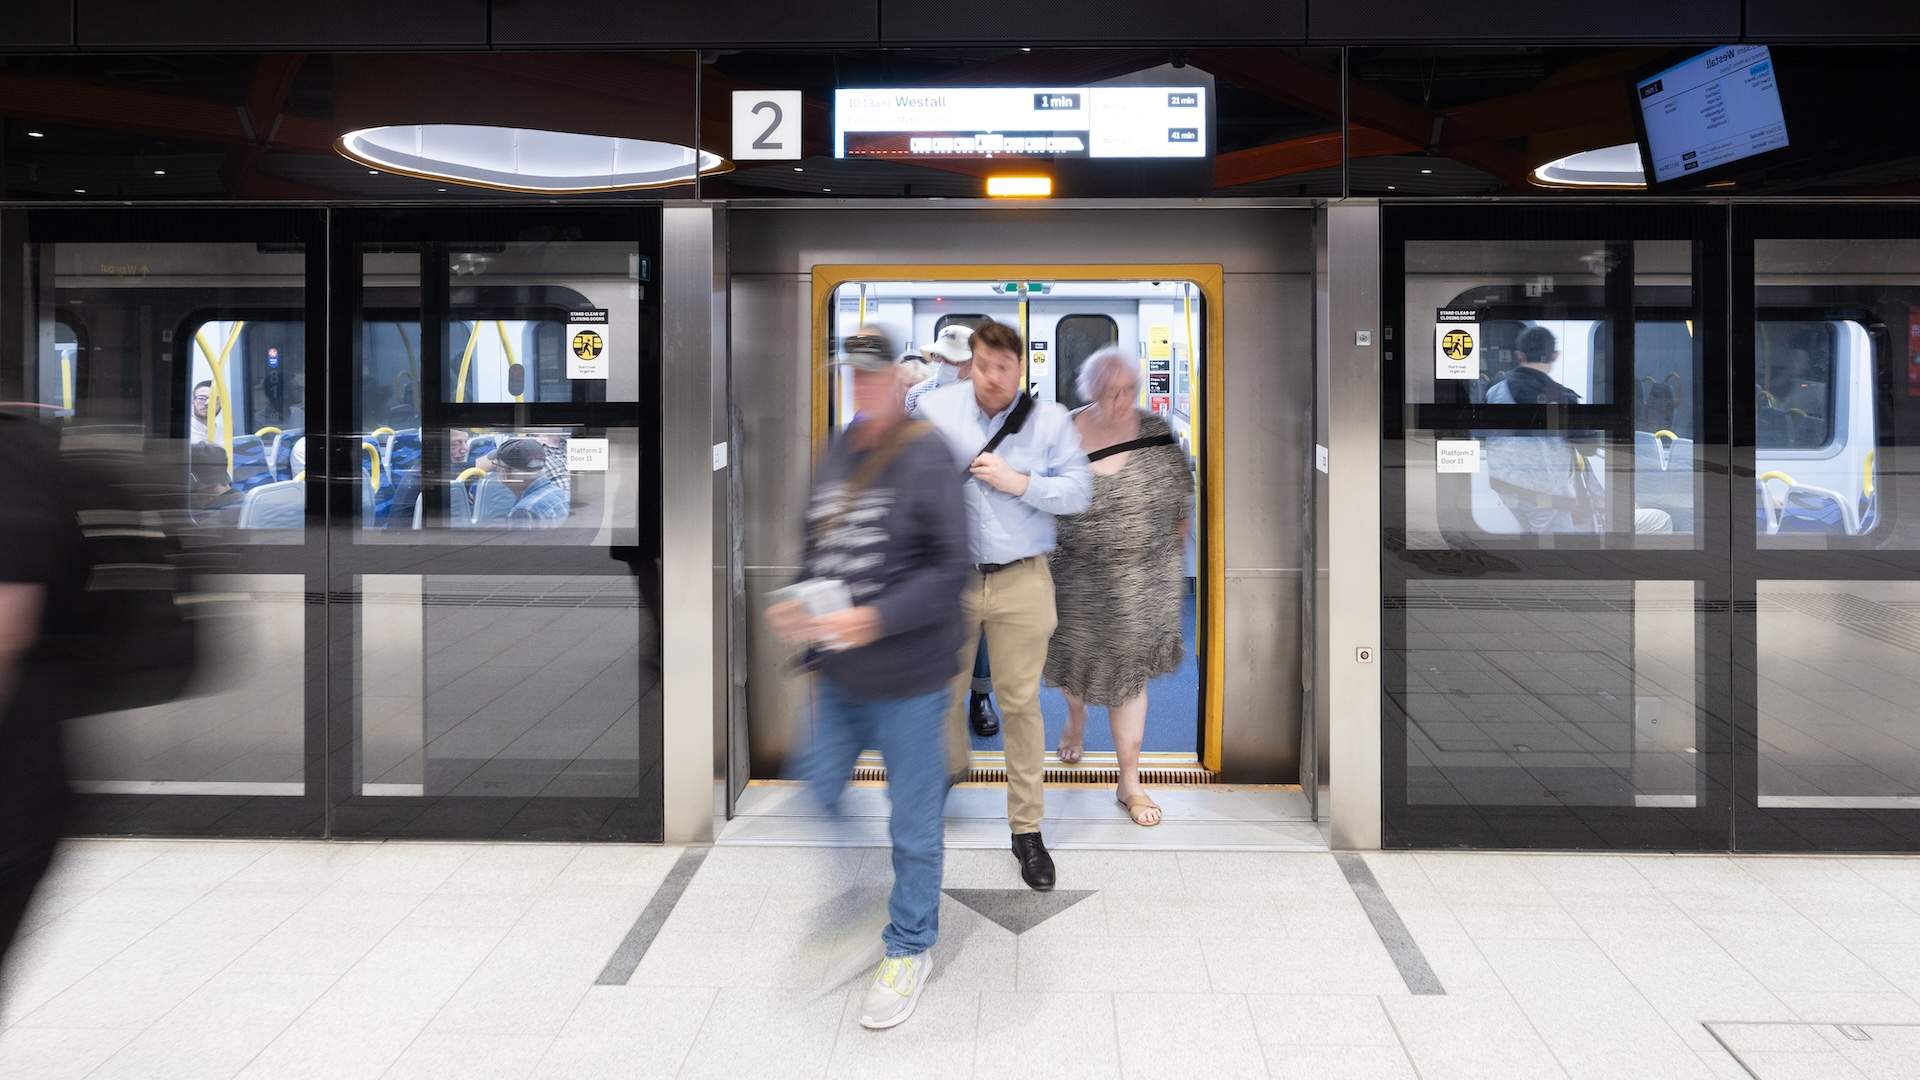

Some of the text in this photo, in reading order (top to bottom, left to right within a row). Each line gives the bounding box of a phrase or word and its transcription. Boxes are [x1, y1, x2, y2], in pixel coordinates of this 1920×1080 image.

[895, 95, 946, 108] Westall
[1041, 95, 1073, 108] 1 min
[1171, 96, 1195, 105] 21 min
[751, 100, 783, 150] 2
[1171, 131, 1195, 140] 41 min
[1441, 457, 1464, 465] Door 11
